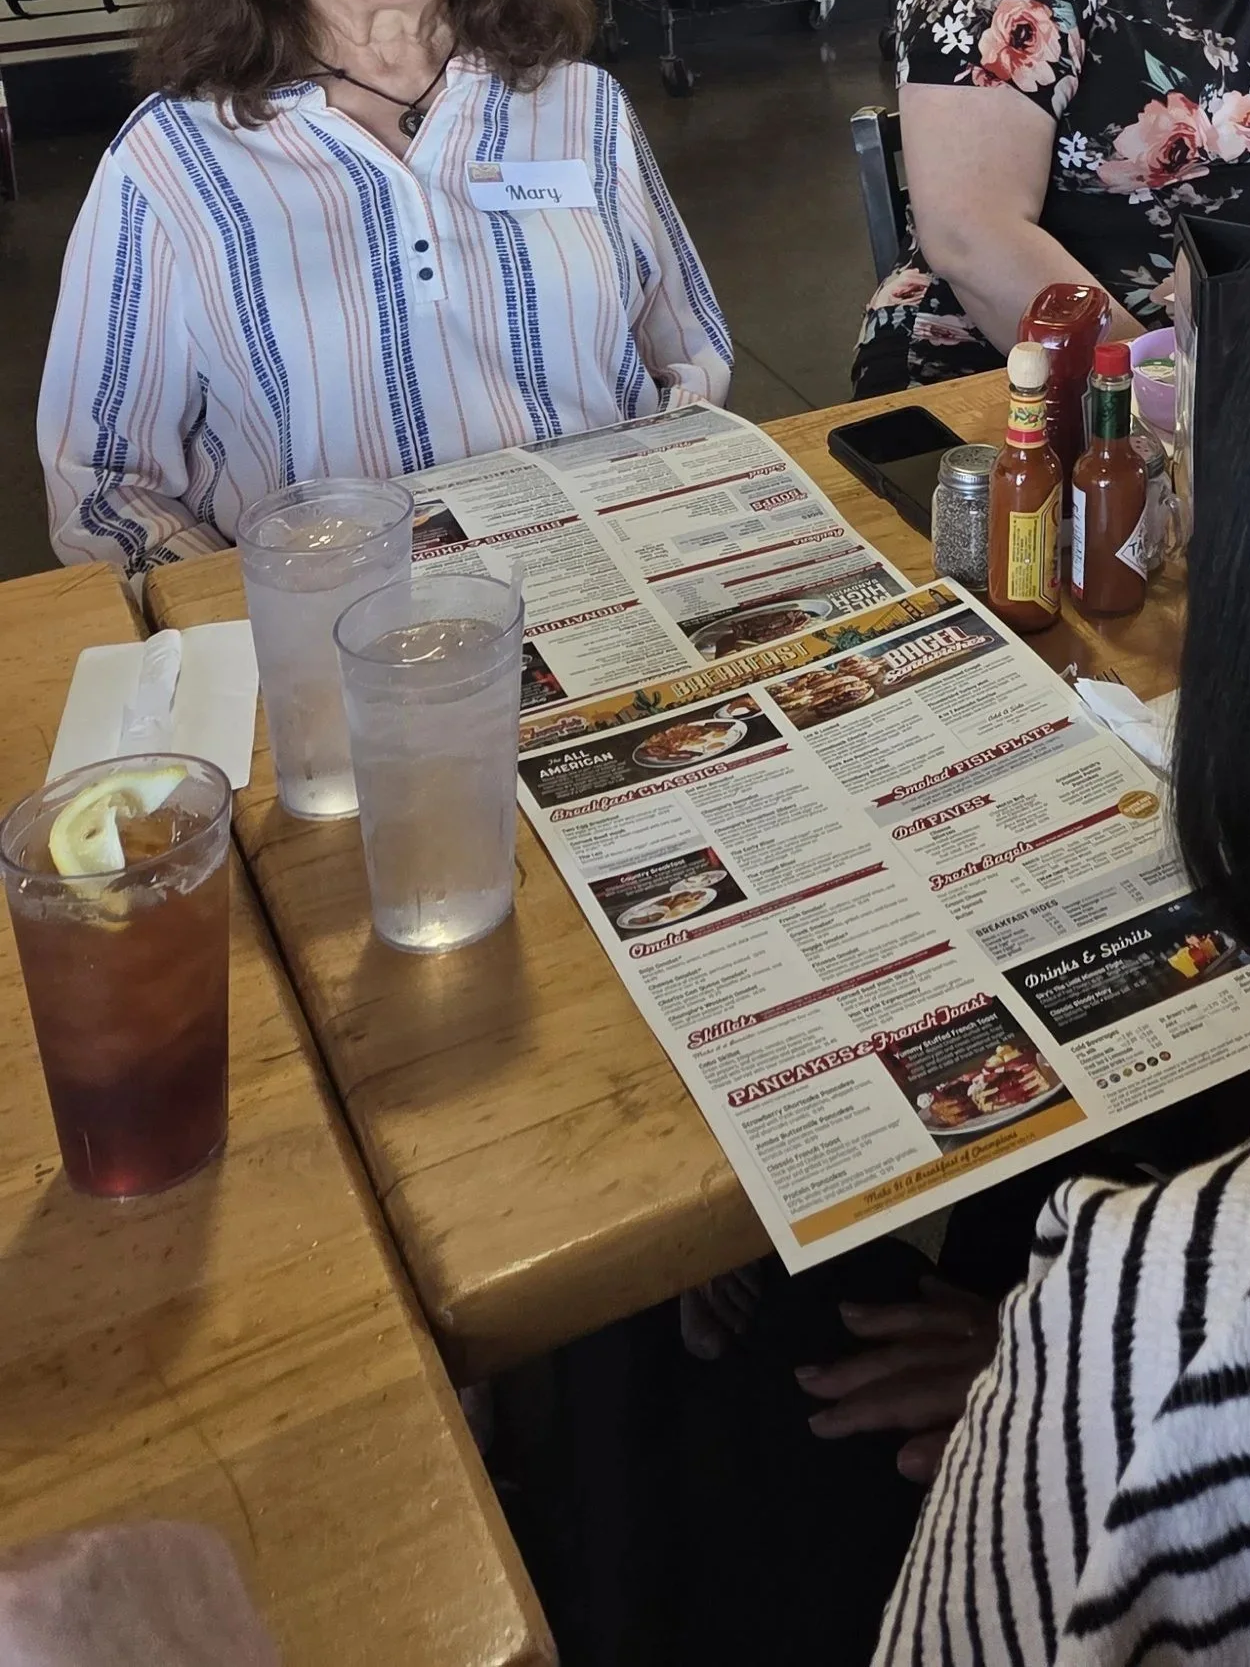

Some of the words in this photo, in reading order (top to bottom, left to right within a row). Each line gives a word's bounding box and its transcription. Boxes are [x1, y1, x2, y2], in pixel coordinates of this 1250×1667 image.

[505, 184, 562, 203] Mary
[752, 488, 800, 510] SOUPS
[485, 520, 563, 544] BURGERS
[827, 578, 879, 598] SANDWICH
[831, 583, 891, 609] HIGH
[526, 604, 625, 636] SIGNATURE
[882, 625, 969, 668] BAGEL
[882, 636, 987, 683] Sandwiches
[670, 642, 811, 697] BREAKFAST
[539, 752, 613, 778] AMERICAN
[561, 749, 589, 763] ALL
[891, 769, 952, 799] Smoked
[953, 750, 996, 773] FISH
[998, 725, 1055, 752] PLATE
[550, 790, 634, 822] Breakfast
[639, 763, 728, 796] CLASSICS
[891, 820, 927, 840] Deli
[926, 862, 978, 891] Fresh
[978, 840, 1035, 870] Bagels
[975, 912, 1030, 938] BREAKFAST
[1029, 898, 1059, 916] SIDES
[628, 929, 690, 959] Omelet
[1021, 957, 1080, 989] Drinks
[1078, 949, 1098, 964] &
[1096, 926, 1153, 958] Spirits
[686, 1011, 757, 1049] Skillets
[732, 1049, 855, 1105] PANCAKES
[852, 1039, 875, 1056] &
[871, 1012, 939, 1049] French
[935, 993, 989, 1023] Toast
[894, 1044, 923, 1060] Yummy
[922, 1032, 951, 1048] Stuffed
[950, 1021, 977, 1037] French
[976, 1013, 998, 1026] Toast
